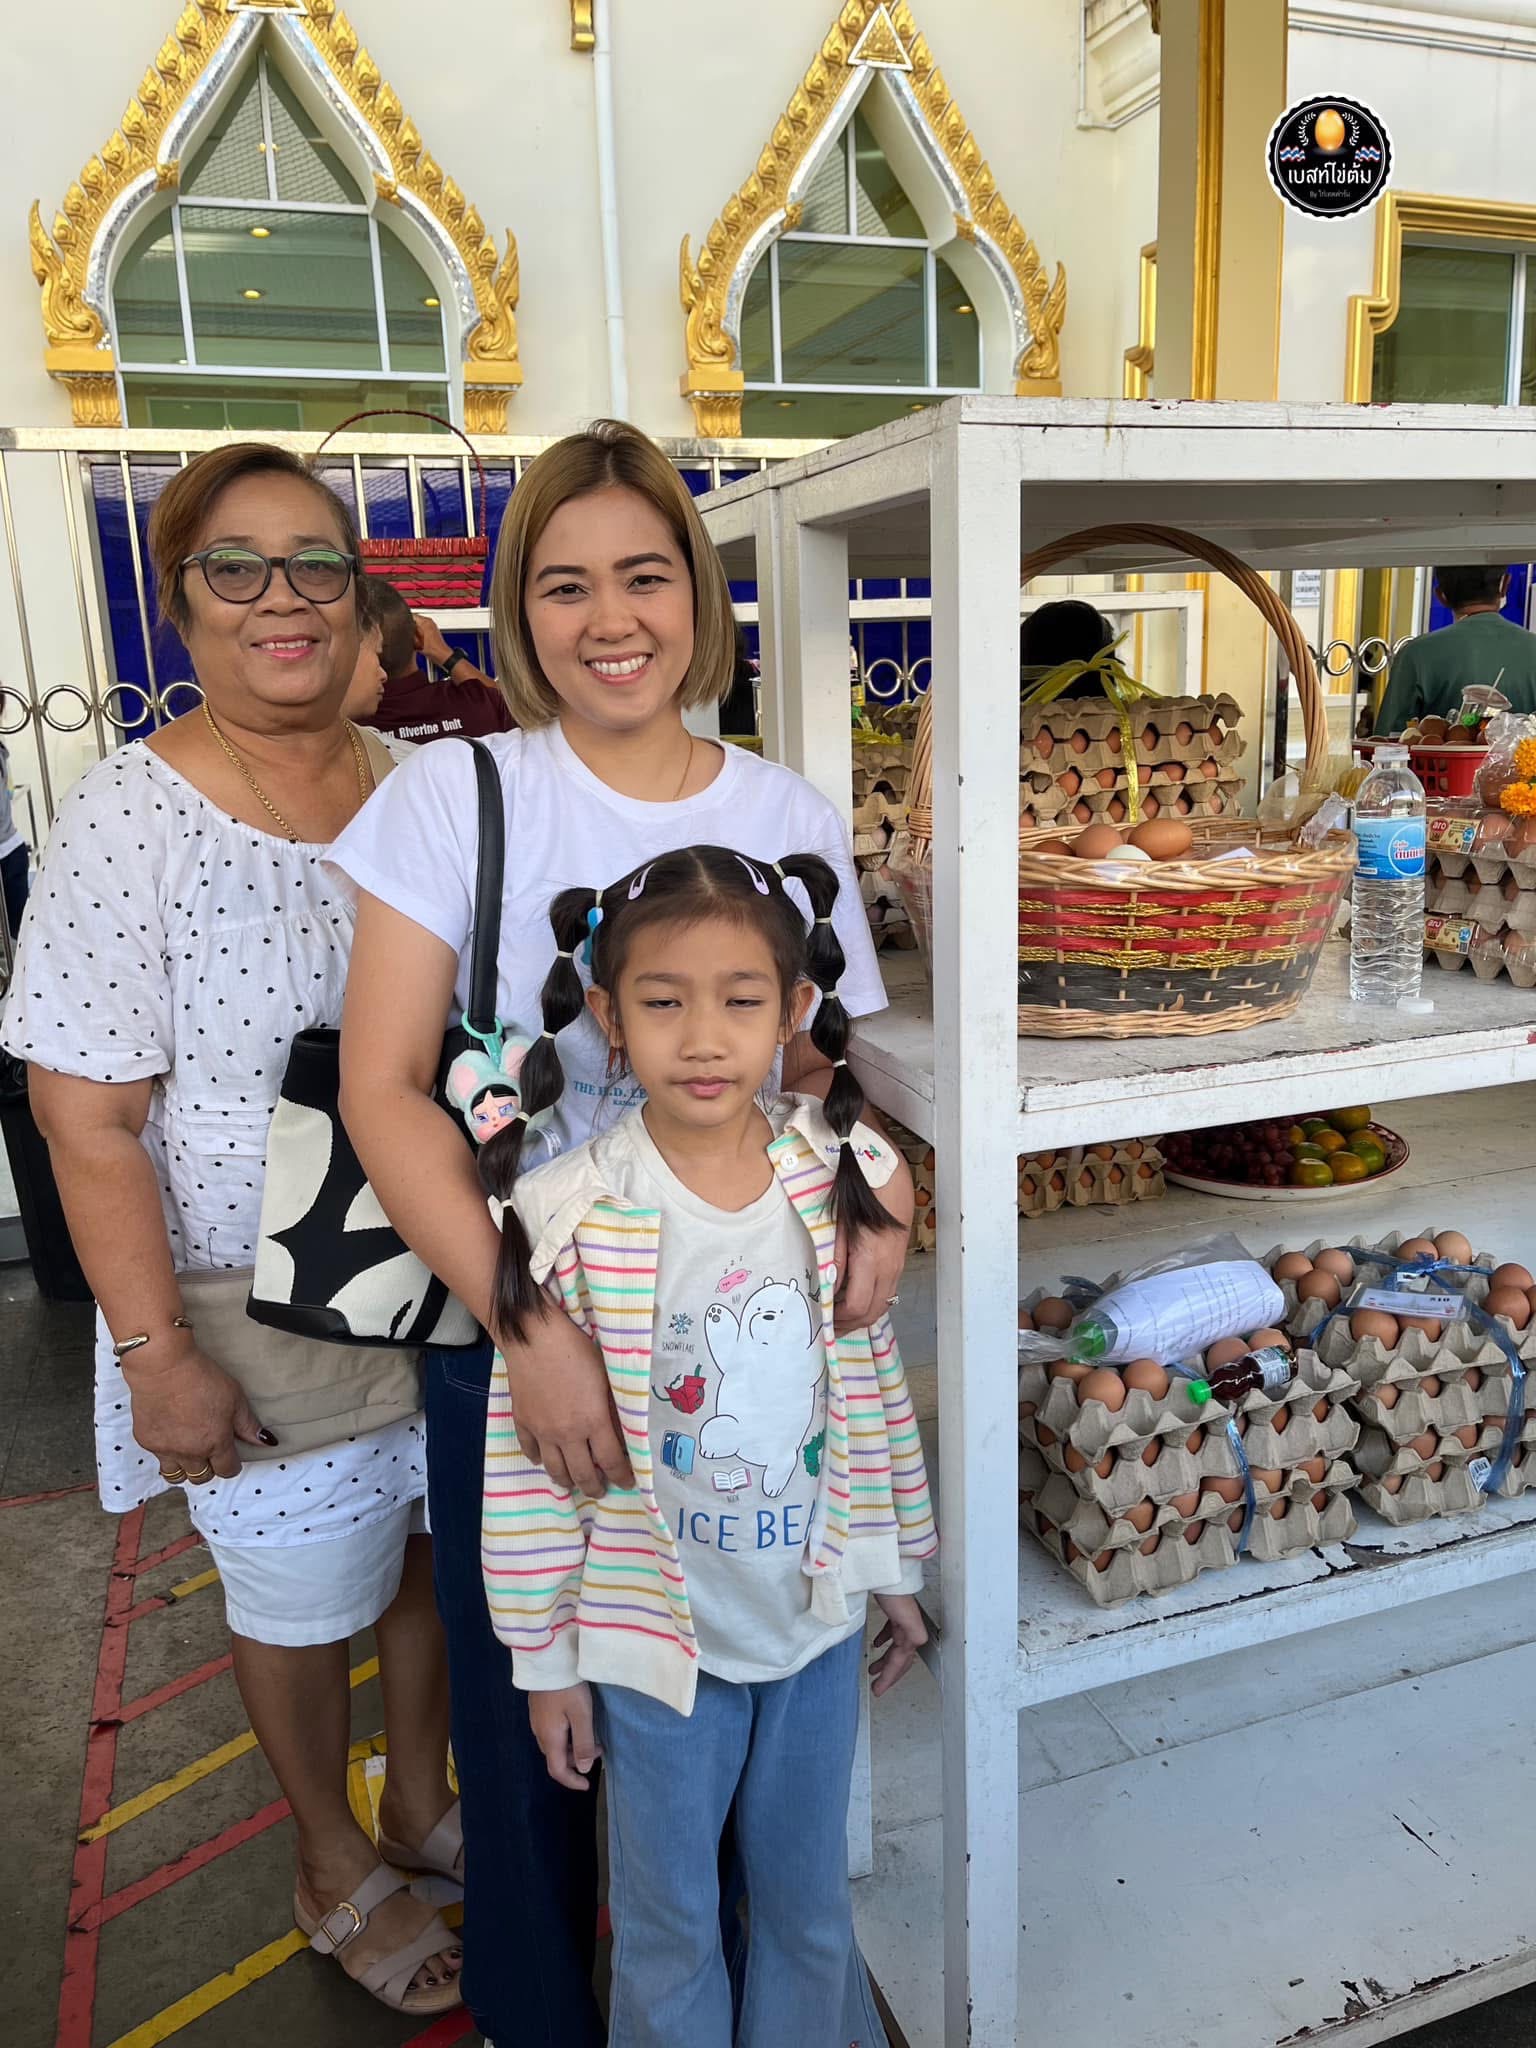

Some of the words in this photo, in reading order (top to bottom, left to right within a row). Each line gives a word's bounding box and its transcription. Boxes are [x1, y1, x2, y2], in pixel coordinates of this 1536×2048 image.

[399, 723, 440, 739] Riverine
[442, 718, 463, 732] Unit
[574, 1081, 596, 1096] THE
[678, 1507, 740, 1553] ICE
